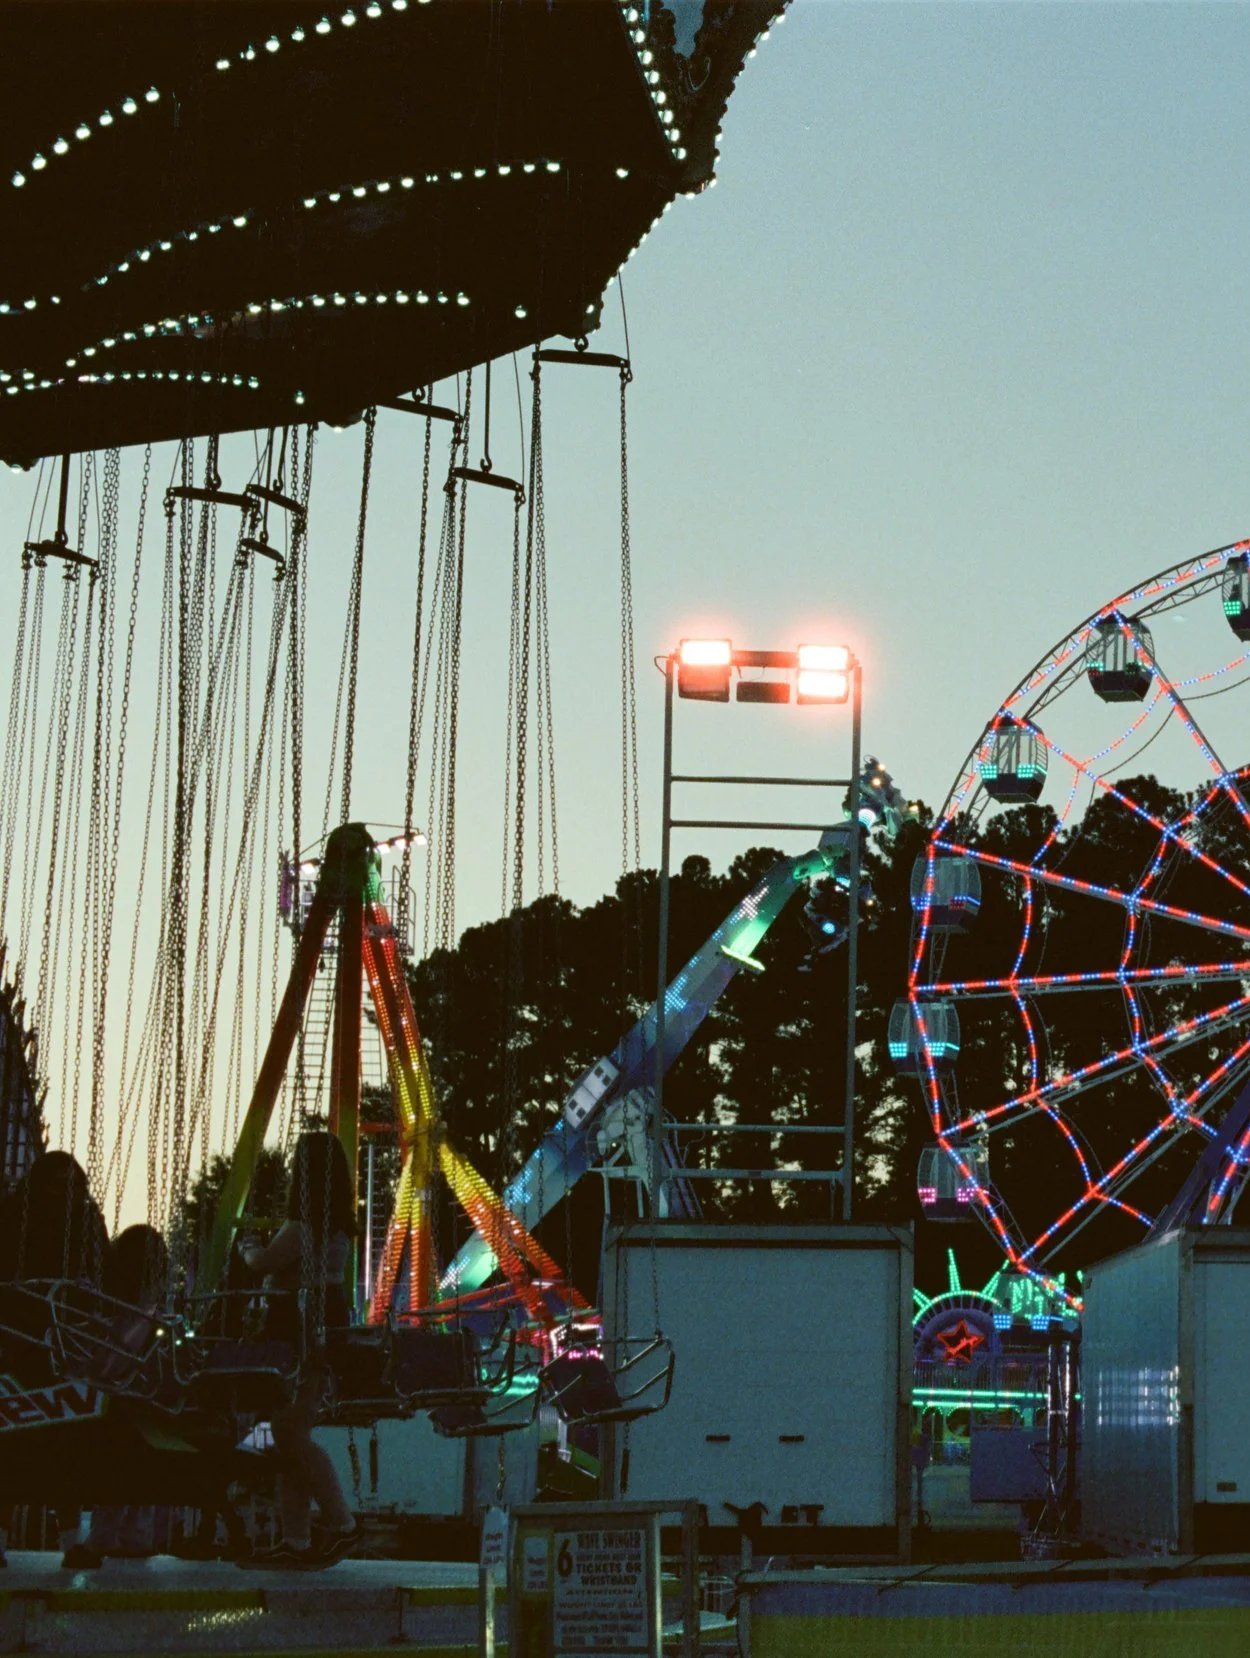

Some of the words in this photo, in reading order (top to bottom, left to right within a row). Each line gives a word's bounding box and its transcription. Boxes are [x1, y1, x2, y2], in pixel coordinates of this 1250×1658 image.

[0, 1381, 97, 1428] ew
[558, 1538, 573, 1577] 6
[576, 1562, 621, 1574] TICKETS
[625, 1562, 642, 1573] OR
